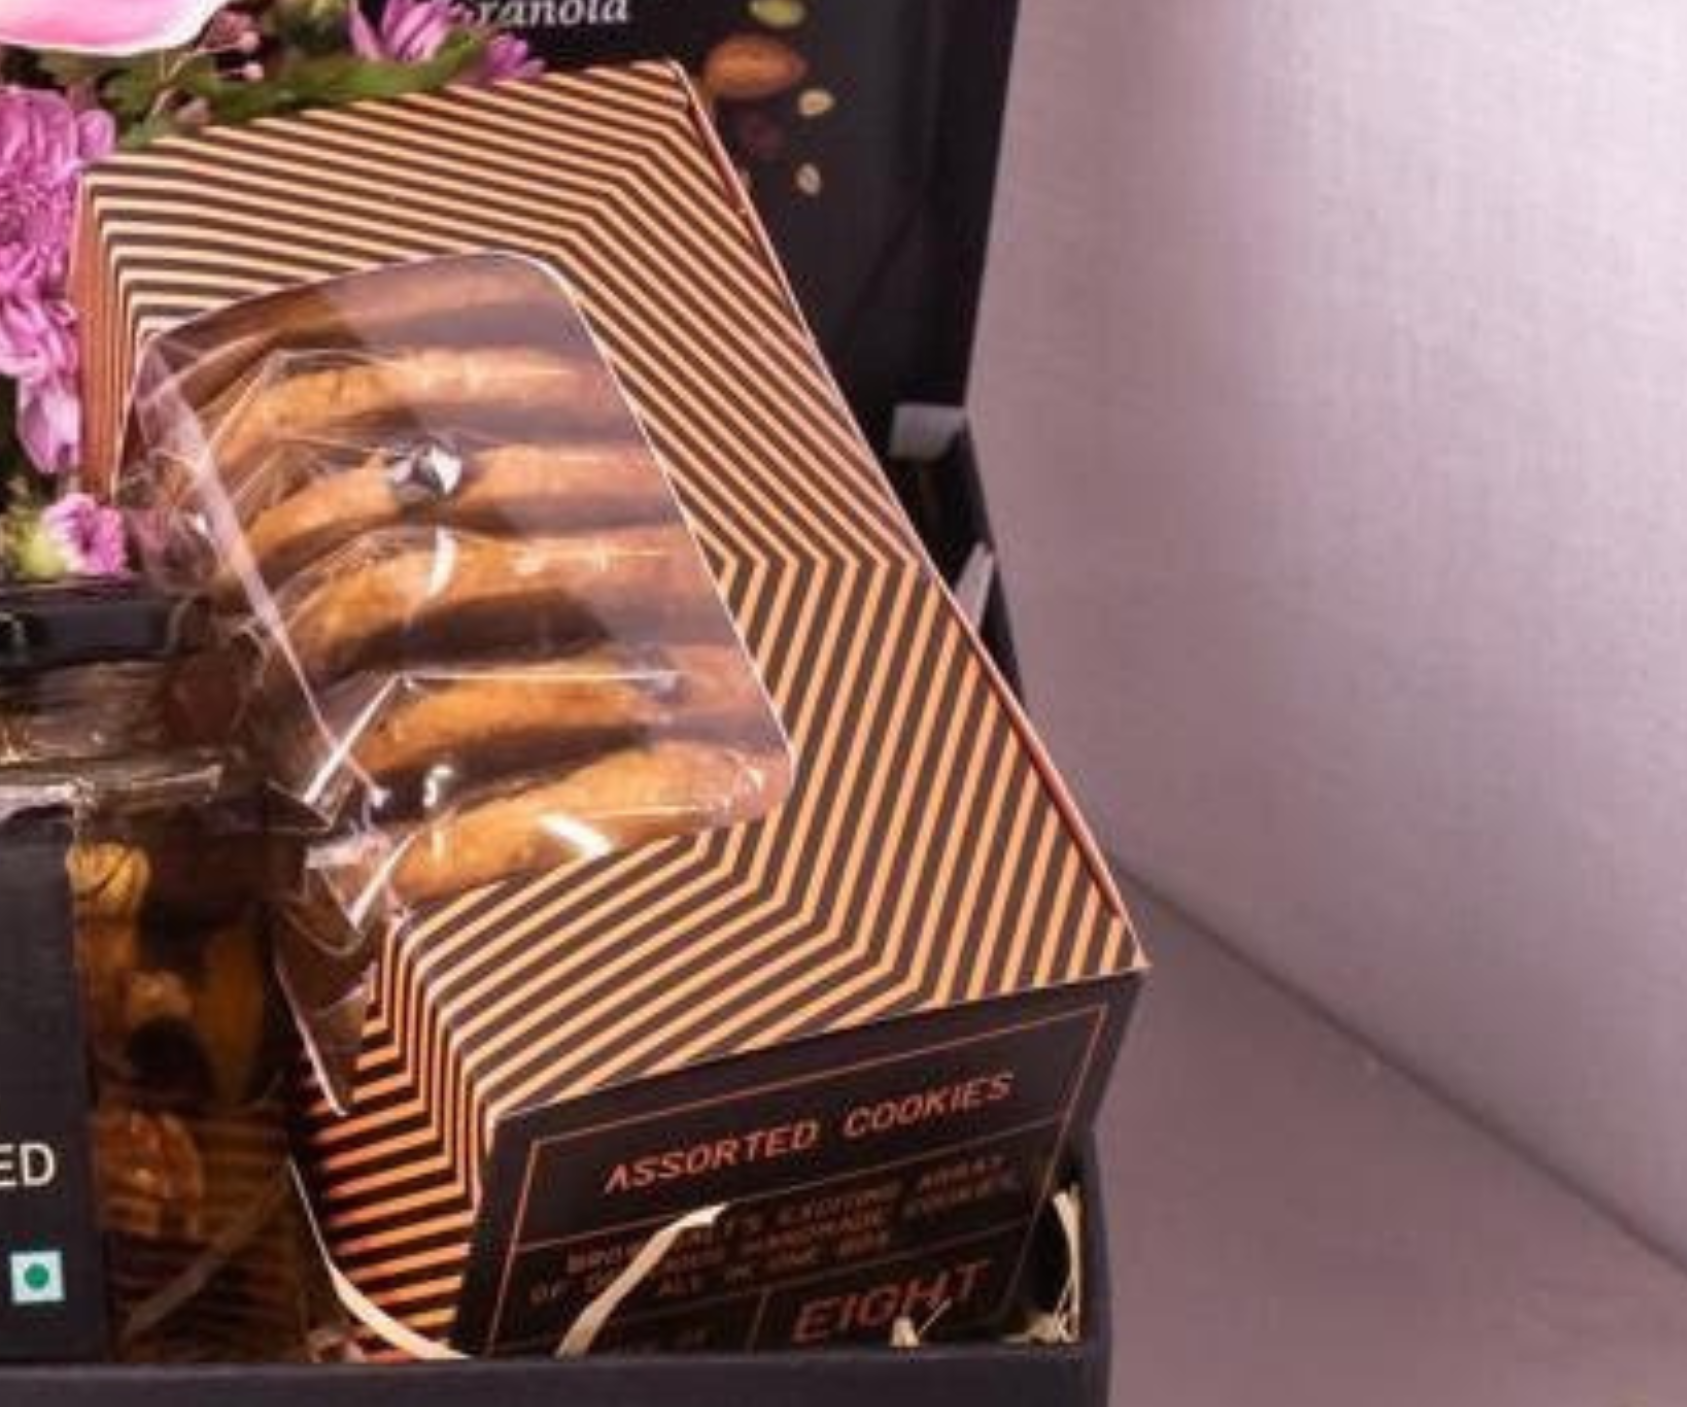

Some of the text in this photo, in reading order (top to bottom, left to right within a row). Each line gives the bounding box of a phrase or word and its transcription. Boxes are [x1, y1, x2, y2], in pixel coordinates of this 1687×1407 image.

[604, 1072, 1014, 1194] ASSORTED COOKIES
[792, 1259, 991, 1342] EIGHT
